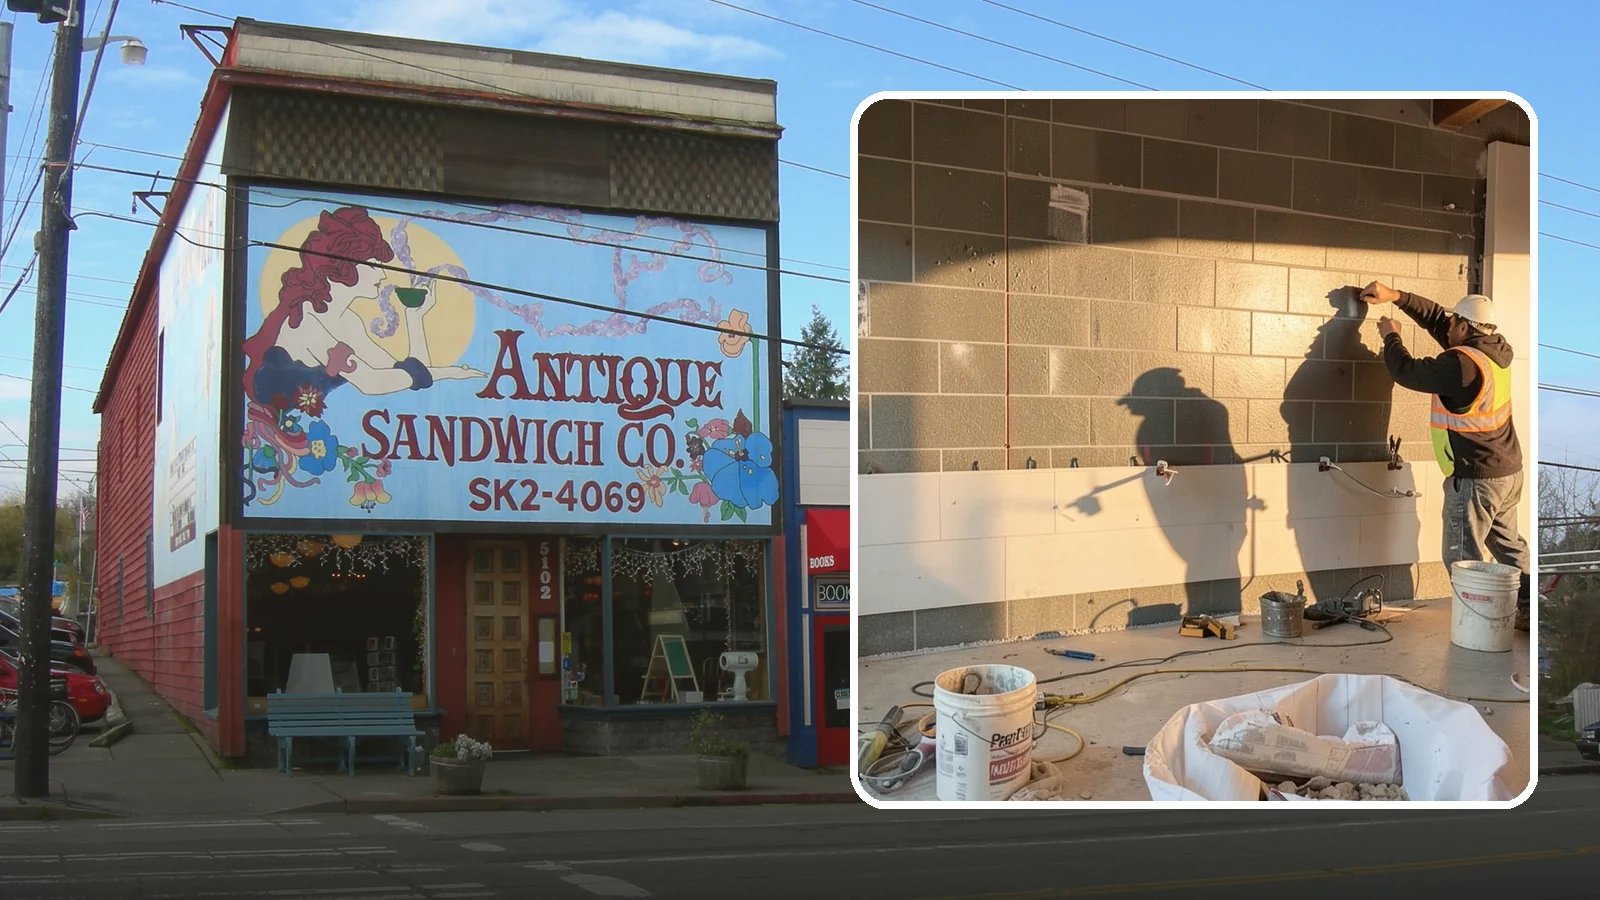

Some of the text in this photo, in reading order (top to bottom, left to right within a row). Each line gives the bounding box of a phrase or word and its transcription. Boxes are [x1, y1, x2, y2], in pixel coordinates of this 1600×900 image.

[475, 329, 723, 421] ANTIQUE
[361, 409, 685, 469] SANDWICH CO.
[468, 477, 645, 513] SK2-4069
[539, 541, 551, 600] 5102
[809, 555, 835, 569] BOOKS
